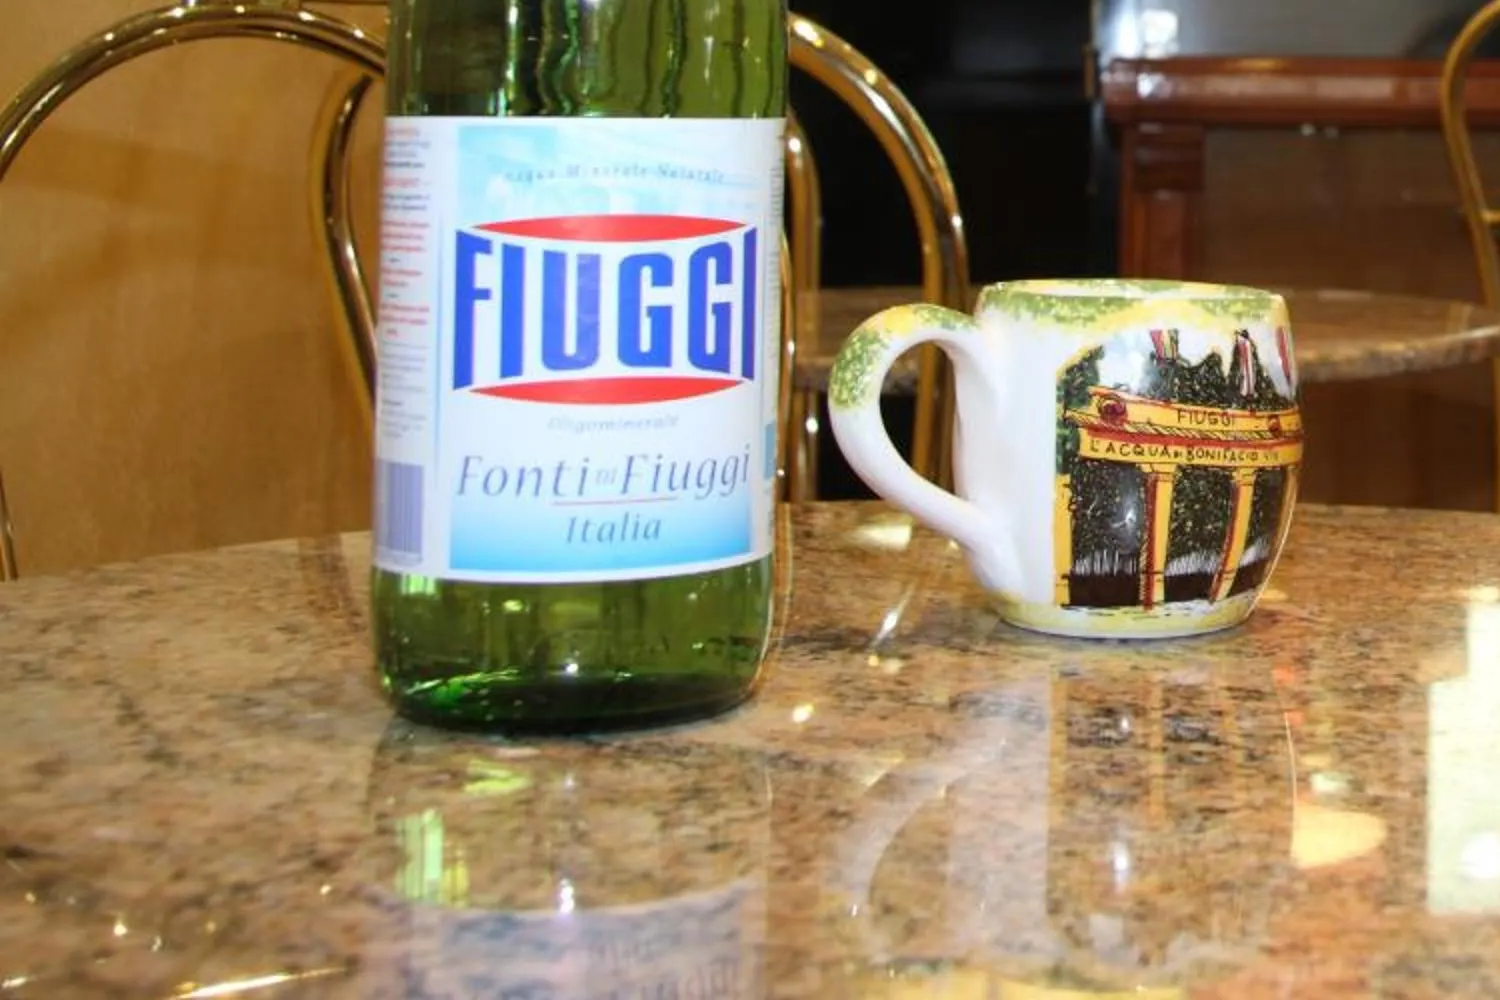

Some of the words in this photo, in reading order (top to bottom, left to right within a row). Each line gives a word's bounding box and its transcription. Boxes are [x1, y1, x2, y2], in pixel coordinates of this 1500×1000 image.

[453, 227, 758, 391] FIUGGI
[456, 454, 590, 498] Fonti
[620, 443, 752, 500] Fiuggi
[566, 511, 663, 543] Italia
